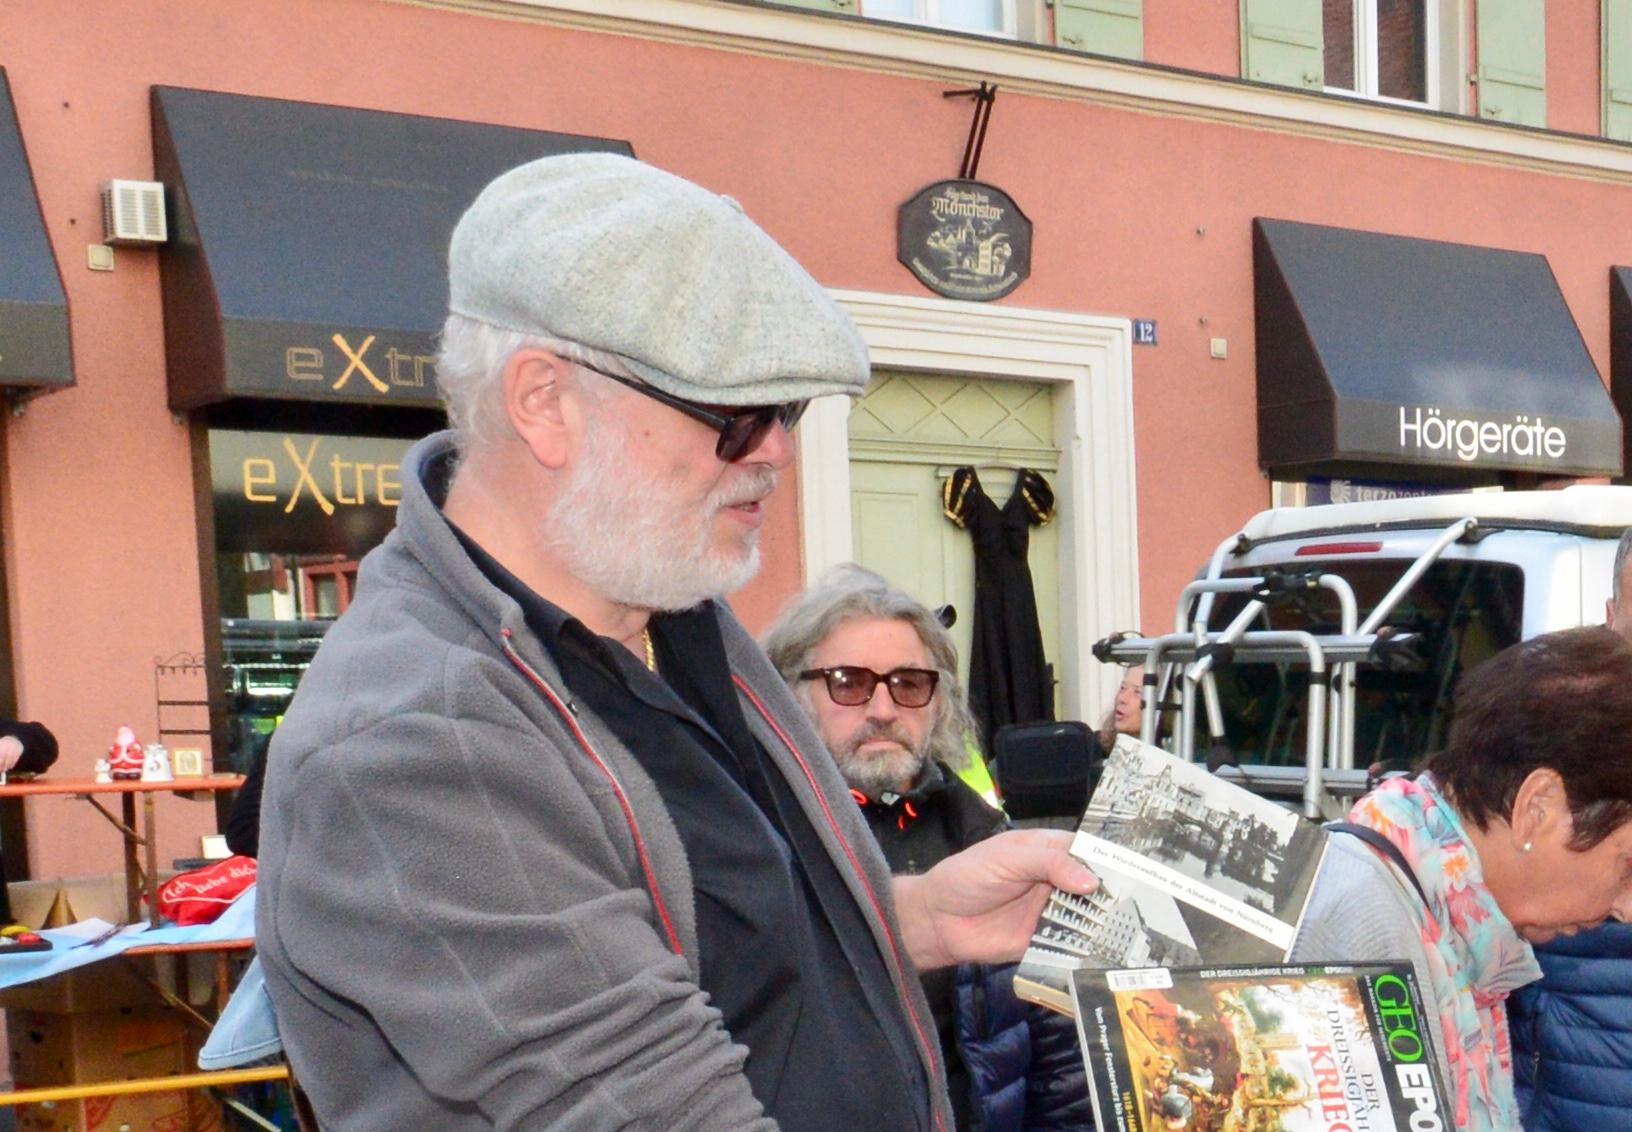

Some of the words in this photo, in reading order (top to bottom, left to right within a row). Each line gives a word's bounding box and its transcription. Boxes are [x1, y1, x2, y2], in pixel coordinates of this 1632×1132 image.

[1140, 322, 1153, 342] 12
[1400, 406, 1566, 461] Hörgeräte
[1375, 974, 1423, 1062] GEO
[1361, 1073, 1381, 1112] DER
